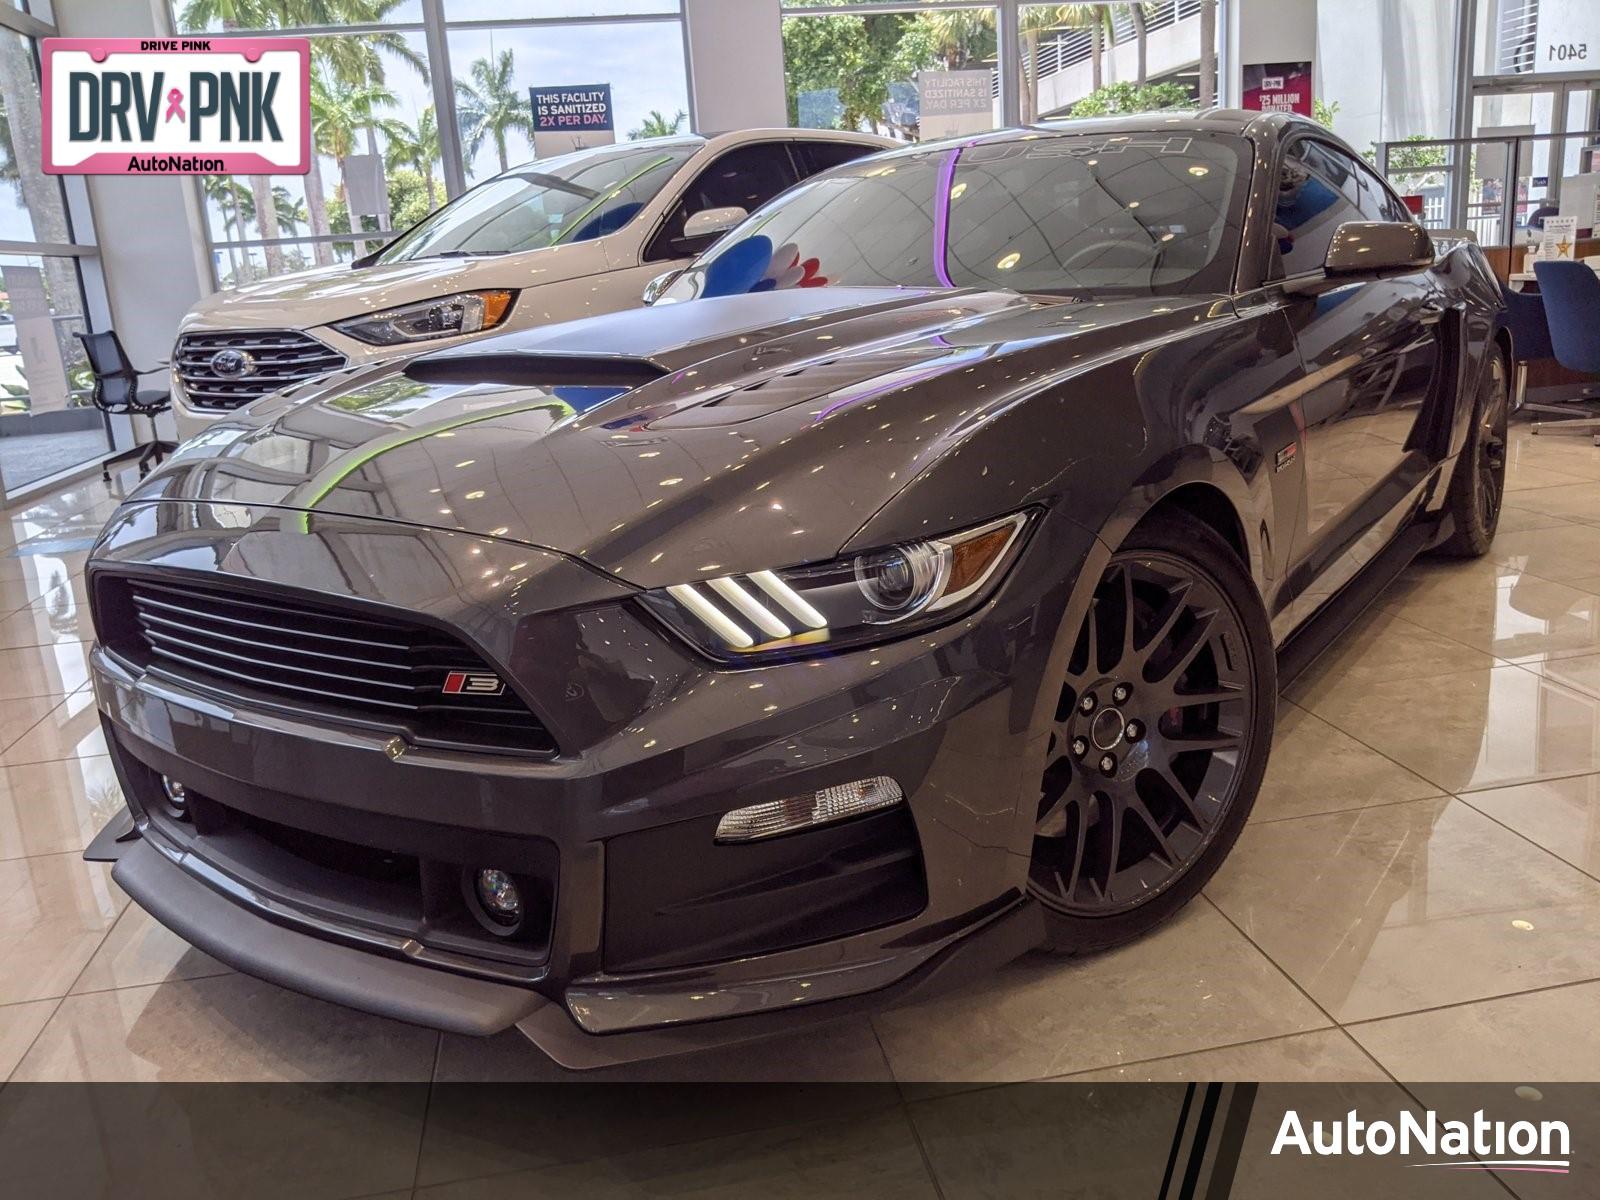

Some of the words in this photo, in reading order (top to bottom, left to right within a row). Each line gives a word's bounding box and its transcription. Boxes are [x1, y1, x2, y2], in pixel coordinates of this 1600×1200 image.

[536, 93, 560, 104] THIS
[562, 92, 605, 102] FACILITY
[1259, 94, 1271, 105] $25
[1272, 93, 1300, 105] MILLION
[538, 105, 549, 116] IS
[551, 104, 607, 115] SANITIZED
[540, 117, 555, 126] 2X
[558, 115, 581, 126] PER
[584, 114, 608, 125] DAY.
